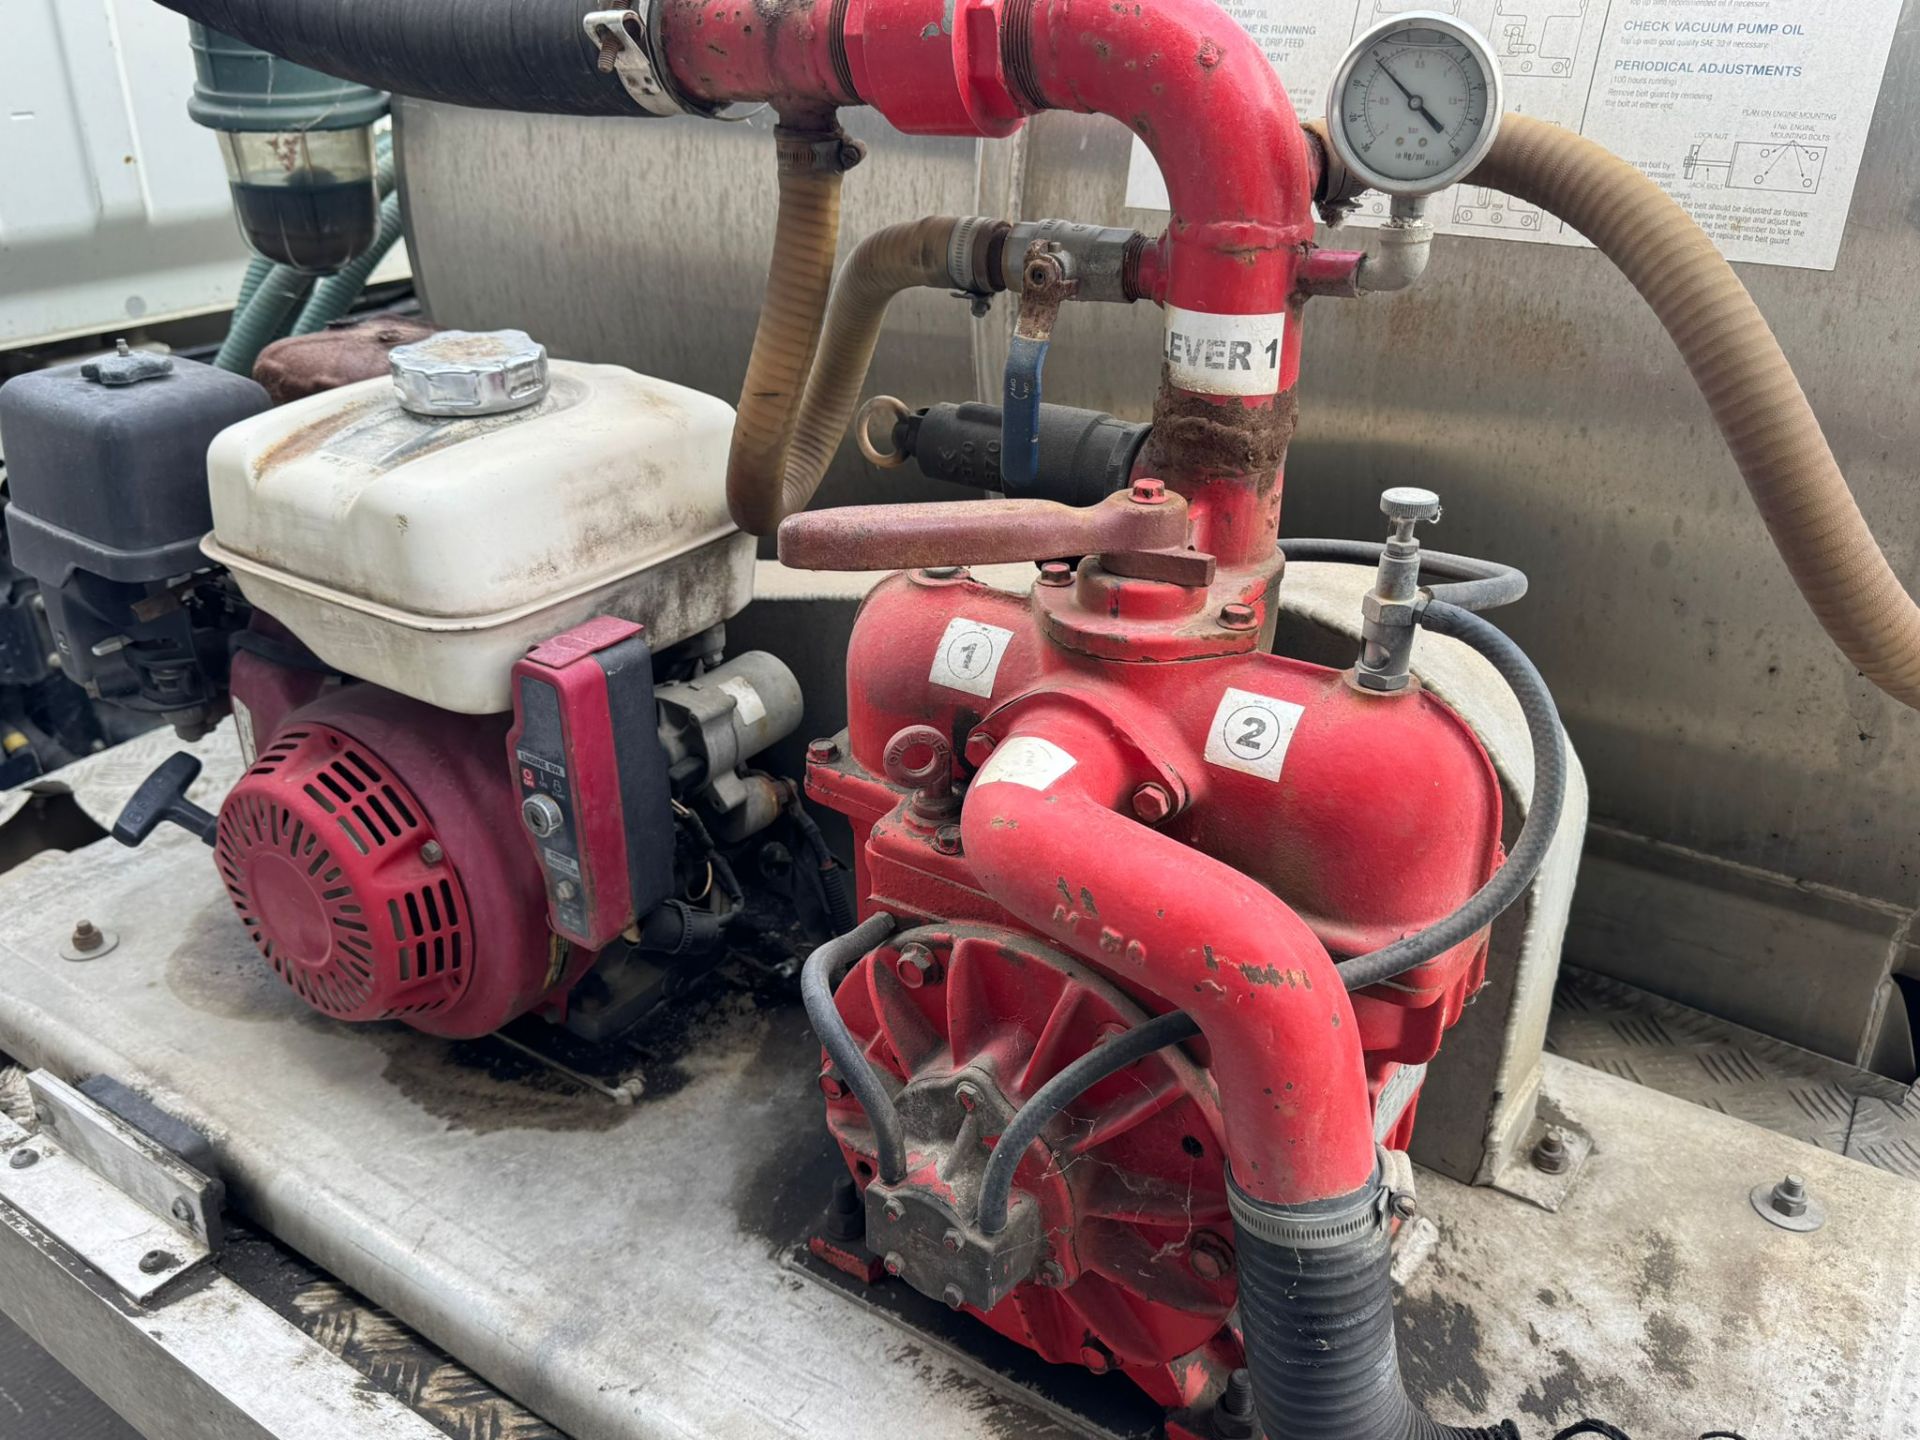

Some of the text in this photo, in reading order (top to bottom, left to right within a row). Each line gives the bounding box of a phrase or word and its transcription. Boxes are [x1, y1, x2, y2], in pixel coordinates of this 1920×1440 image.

[1233, 8, 1256, 18] PUMP
[1257, 9, 1268, 19] OIL
[1259, 24, 1269, 33] IS
[1271, 24, 1316, 35] RUNNING
[1623, 20, 1805, 35] CHECK VACUUM PUMP OIL
[1265, 37, 1283, 47] DRIP
[1284, 38, 1304, 49] FEED
[1658, 38, 1675, 47] good
[1677, 38, 1698, 48] quality
[1700, 39, 1713, 47] SAE
[1614, 60, 1802, 77] PERIODICAL ADJUSTMENTS
[1627, 76, 1647, 84] hours
[1608, 88, 1634, 97] Remove
[1649, 90, 1669, 99] guard
[1670, 91, 1680, 101] by
[1741, 109, 1837, 120] PLAN ON ENGINE MOUNTING
[1694, 131, 1728, 140] LOCK NUT
[1770, 131, 1831, 142] MOUNTING BOLTS
[1708, 203, 1731, 211] should
[1732, 204, 1741, 212] be
[1742, 205, 1771, 214] adjusted
[1694, 210, 1715, 219] below
[1716, 212, 1727, 221] the
[1752, 215, 1766, 223] and
[1767, 217, 1788, 227] adjust
[1790, 219, 1801, 227] the
[1701, 221, 1712, 229] the
[1777, 227, 1791, 236] lock
[1793, 228, 1804, 237] the
[1716, 231, 1741, 241] replace
[1742, 233, 1753, 242] the
[1755, 234, 1768, 243] belt
[1769, 236, 1790, 245] guard
[1264, 338, 1278, 369] 1
[960, 642, 978, 670] 1
[1235, 716, 1267, 750] 2
[887, 731, 951, 767] OIL LEVEL
[520, 753, 547, 769] ENGINE
